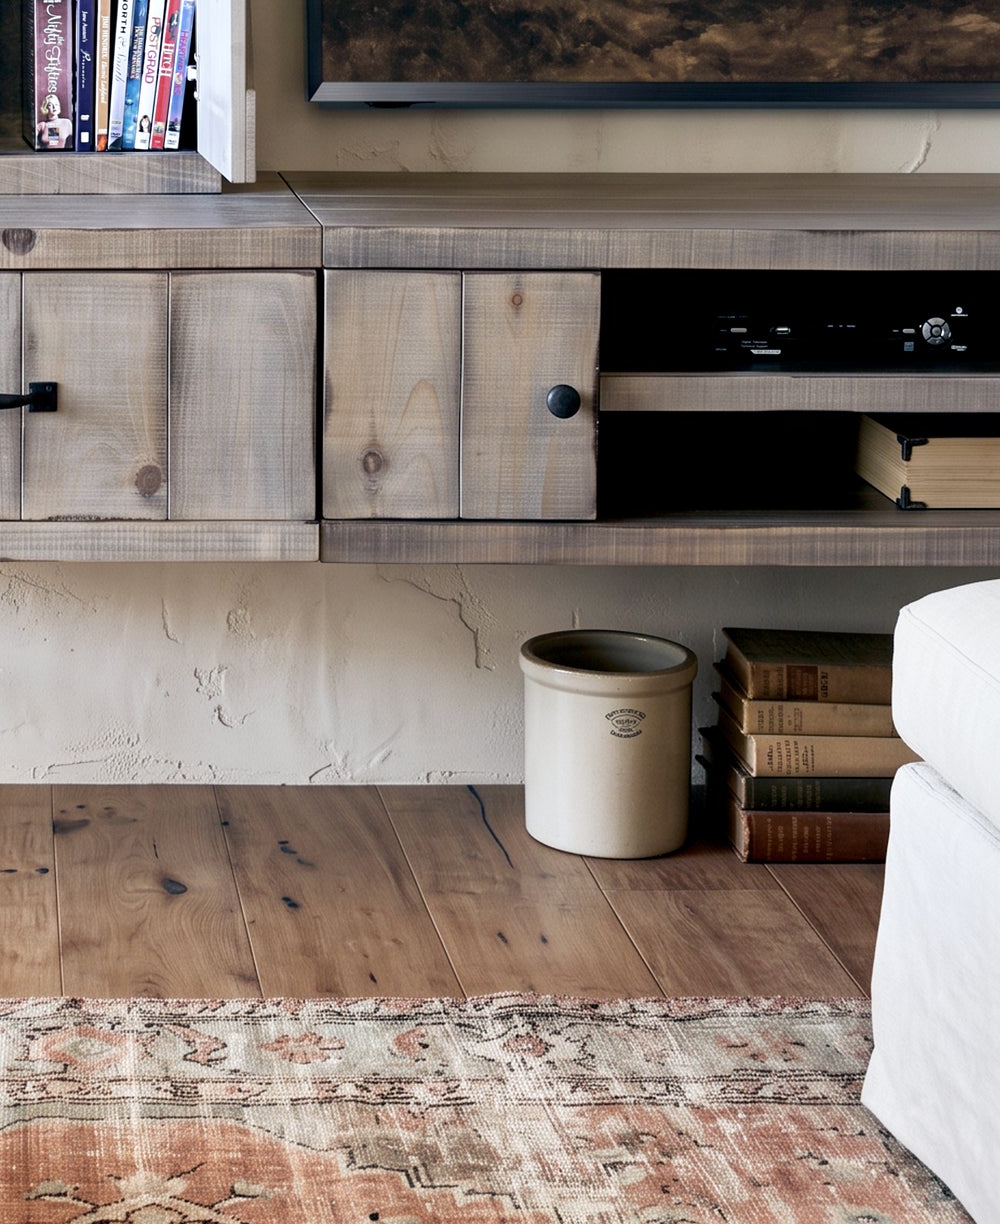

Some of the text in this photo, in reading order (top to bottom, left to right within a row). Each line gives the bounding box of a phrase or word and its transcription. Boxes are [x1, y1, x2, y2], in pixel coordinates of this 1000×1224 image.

[44, 4, 62, 45] Nifty
[101, 16, 109, 29] JIMI
[144, 17, 161, 85] POST GRAD
[160, 42, 175, 78] HITCH
[178, 30, 189, 58] HEART
[44, 46, 61, 93] Fifties
